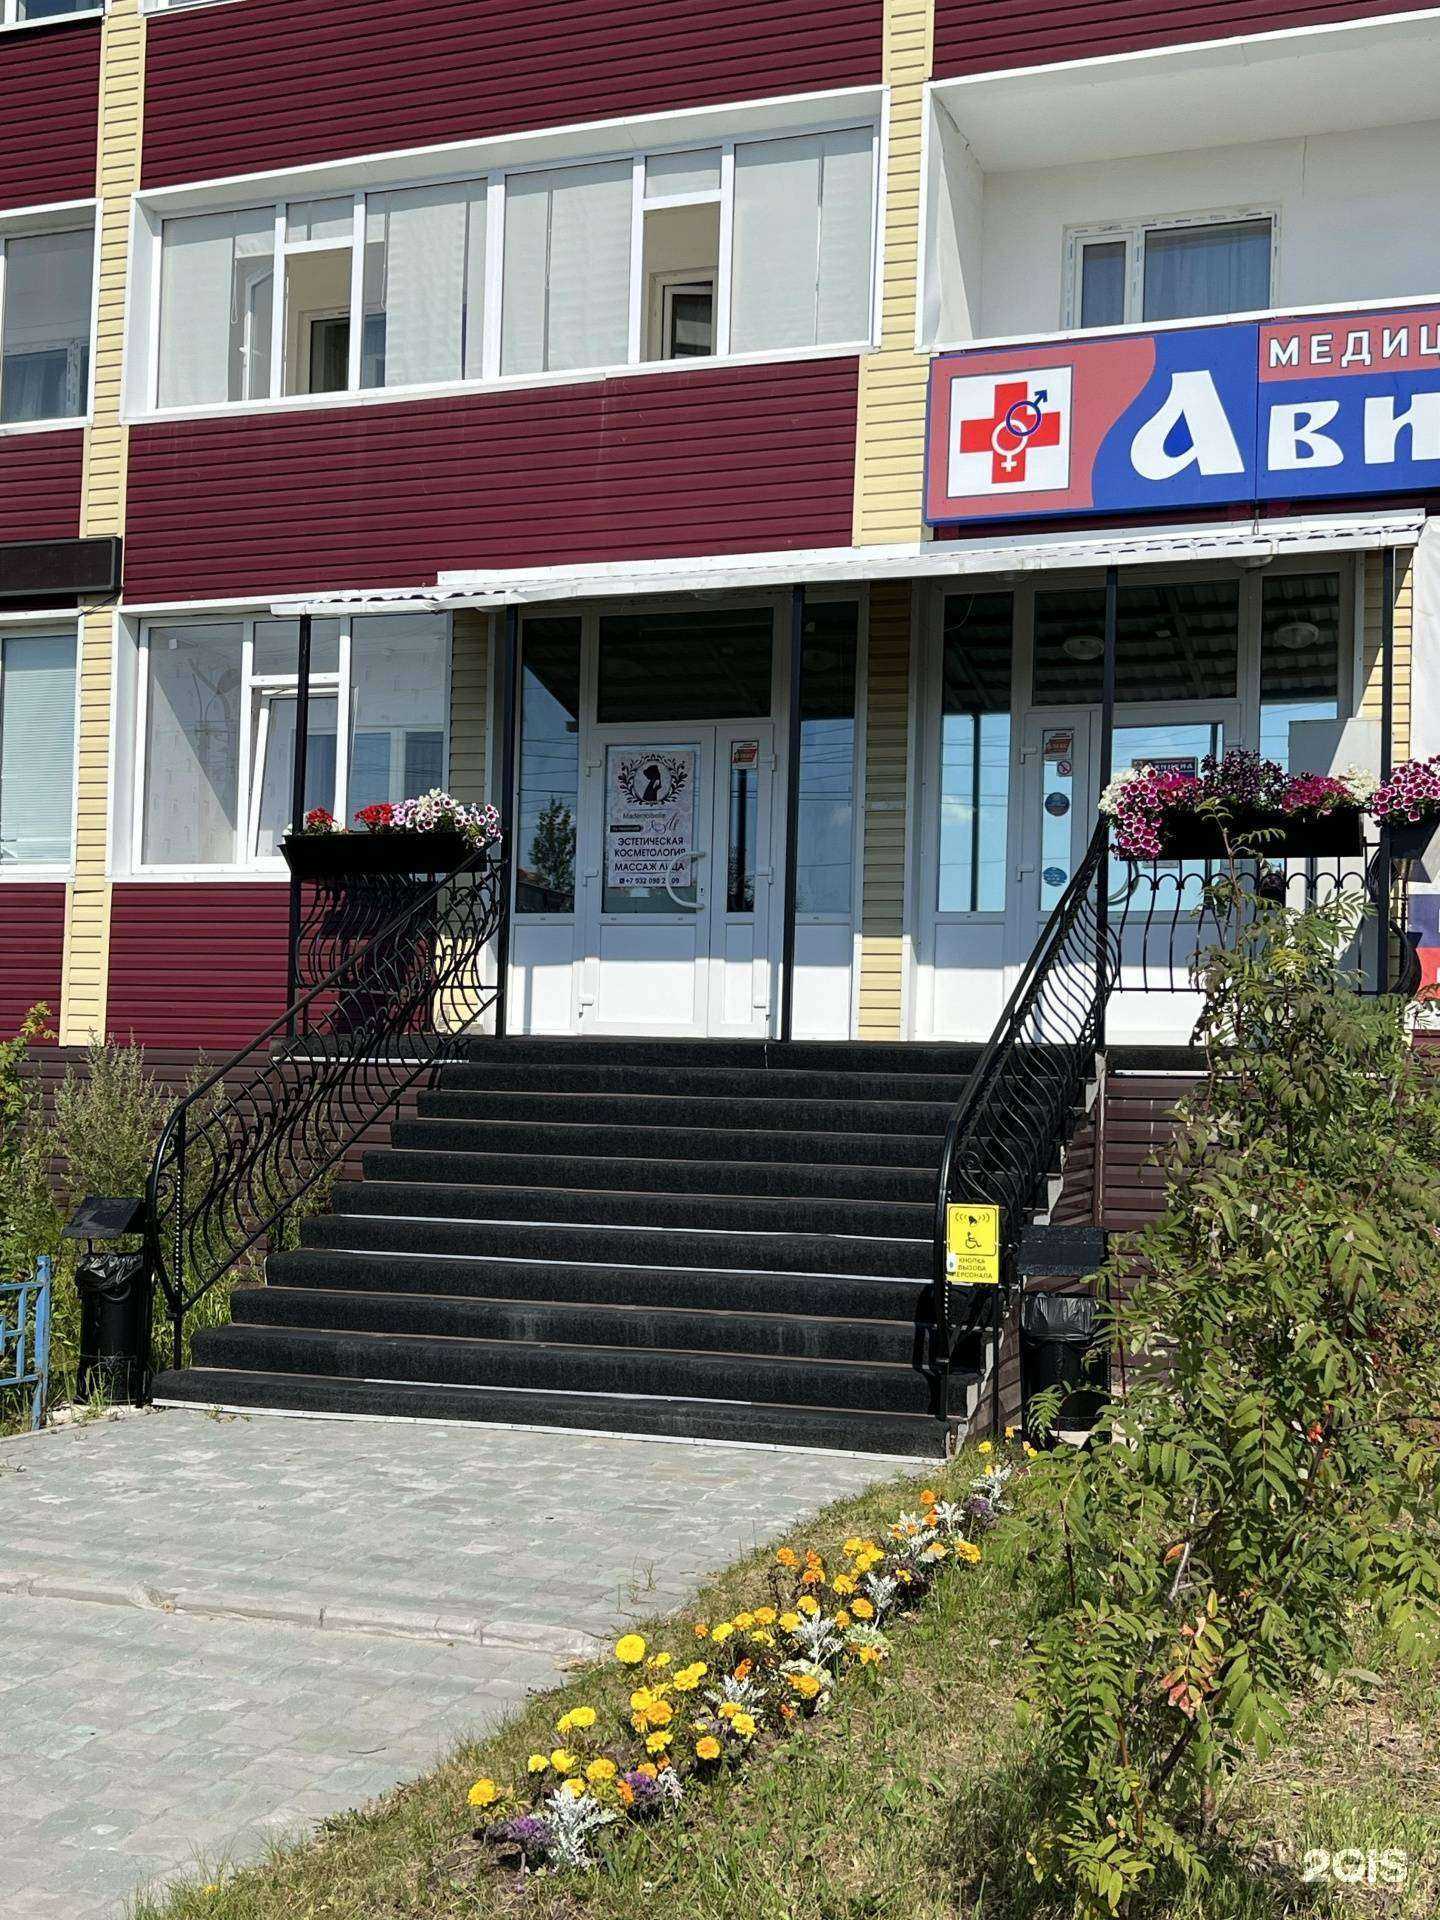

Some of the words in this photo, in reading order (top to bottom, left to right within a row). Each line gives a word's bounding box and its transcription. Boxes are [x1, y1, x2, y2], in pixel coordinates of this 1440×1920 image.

[617, 837, 684, 846] ЭСТЕТИЧЕСКАЯ
[614, 863, 657, 871] МАССАЖ
[955, 1271, 993, 1279] ЕРСОНАЛА
